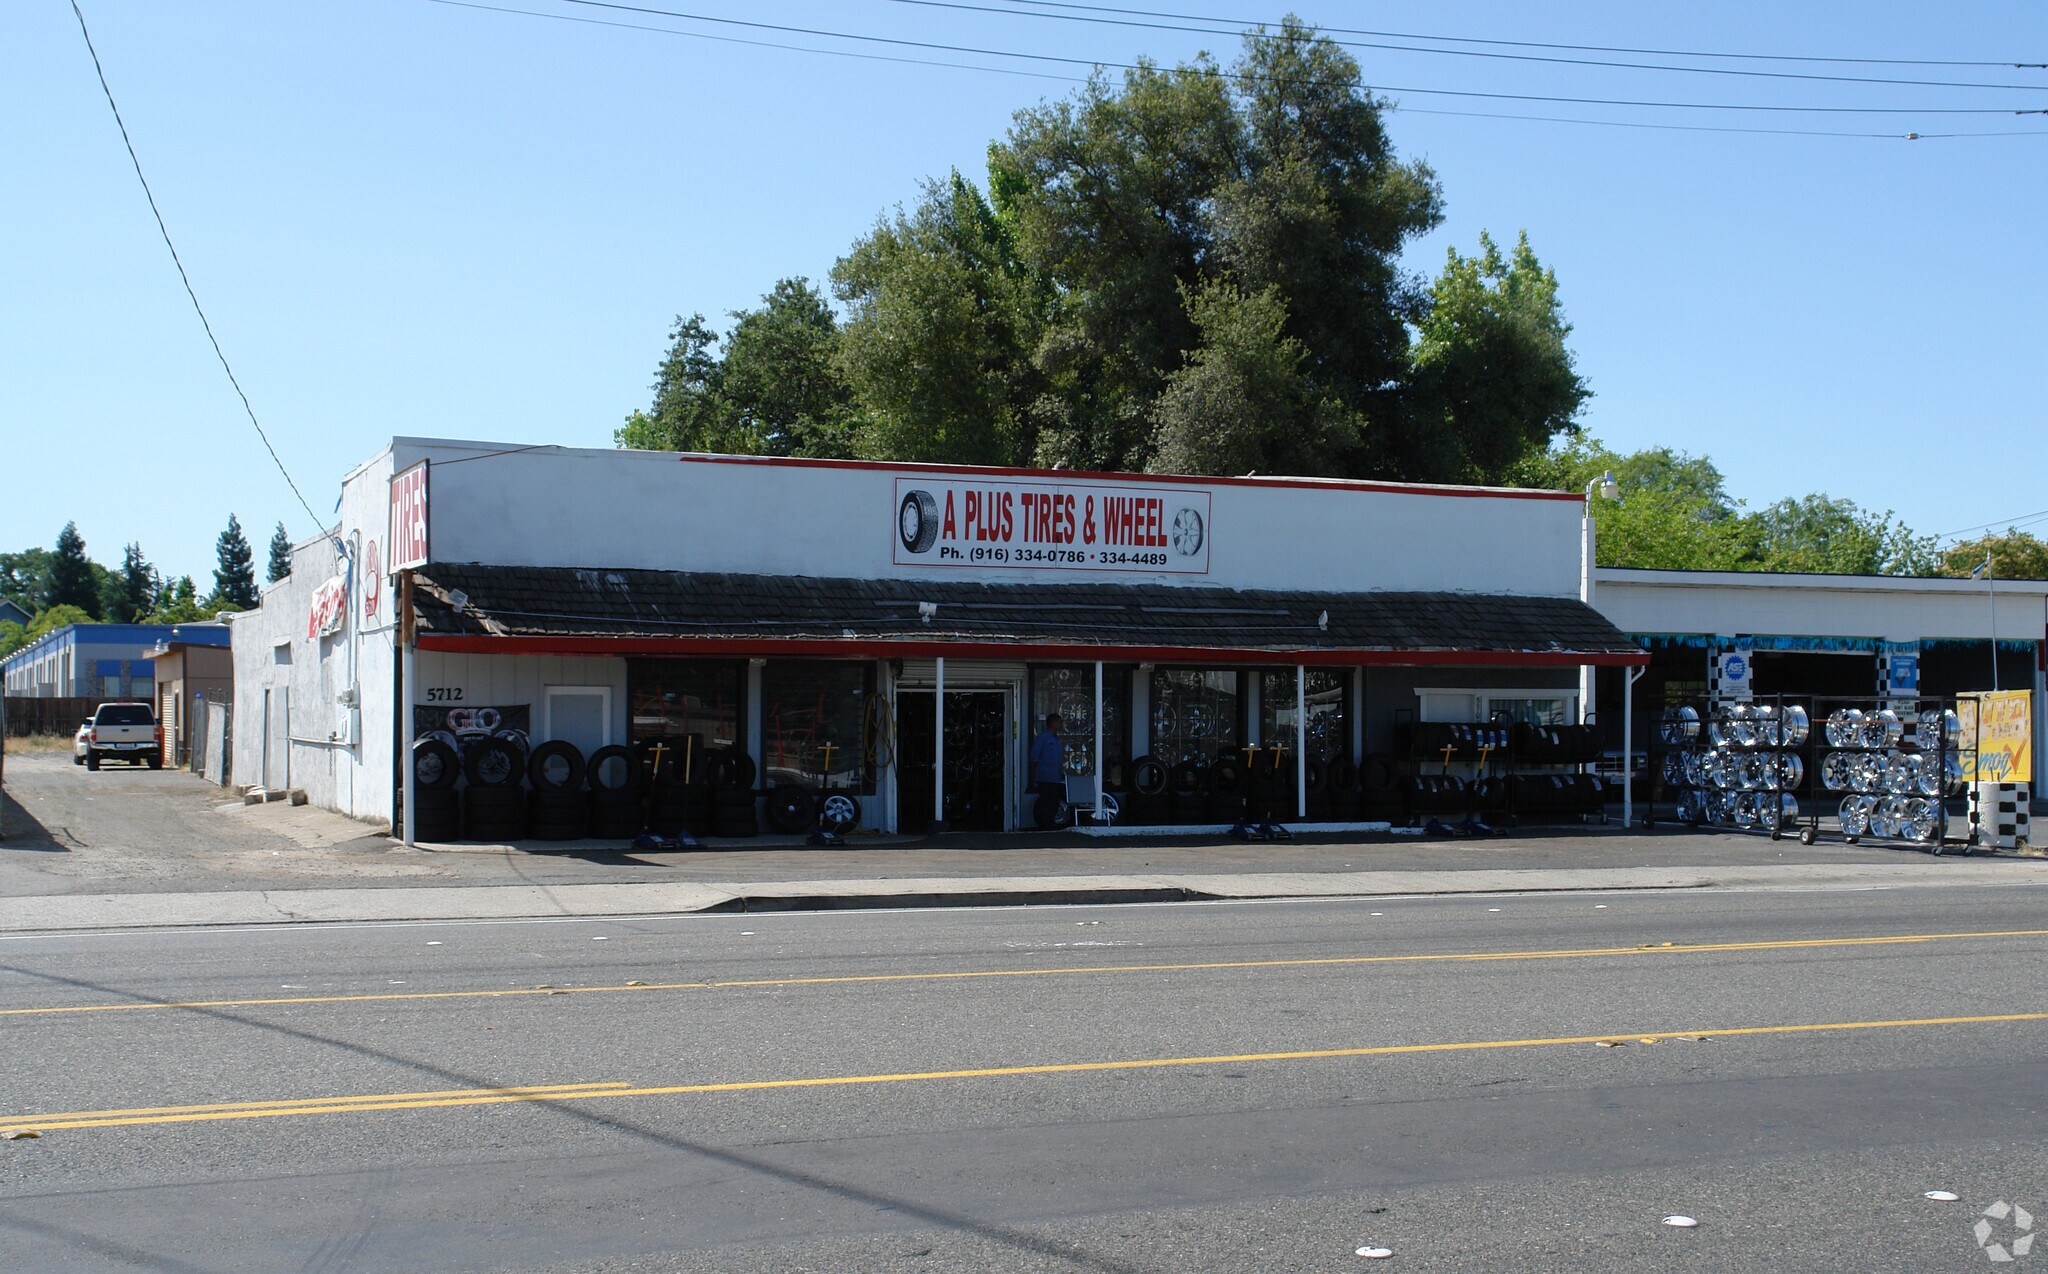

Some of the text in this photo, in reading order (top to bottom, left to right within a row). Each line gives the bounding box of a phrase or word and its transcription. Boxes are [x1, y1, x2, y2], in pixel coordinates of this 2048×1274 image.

[392, 466, 427, 567] TIRES
[942, 489, 1168, 547] A PLUS TIRES & WHEEL
[941, 546, 1167, 565] Ph. (916) 334-0786 334-4489
[1727, 662, 1744, 671] ASE
[427, 687, 463, 701] 5712
